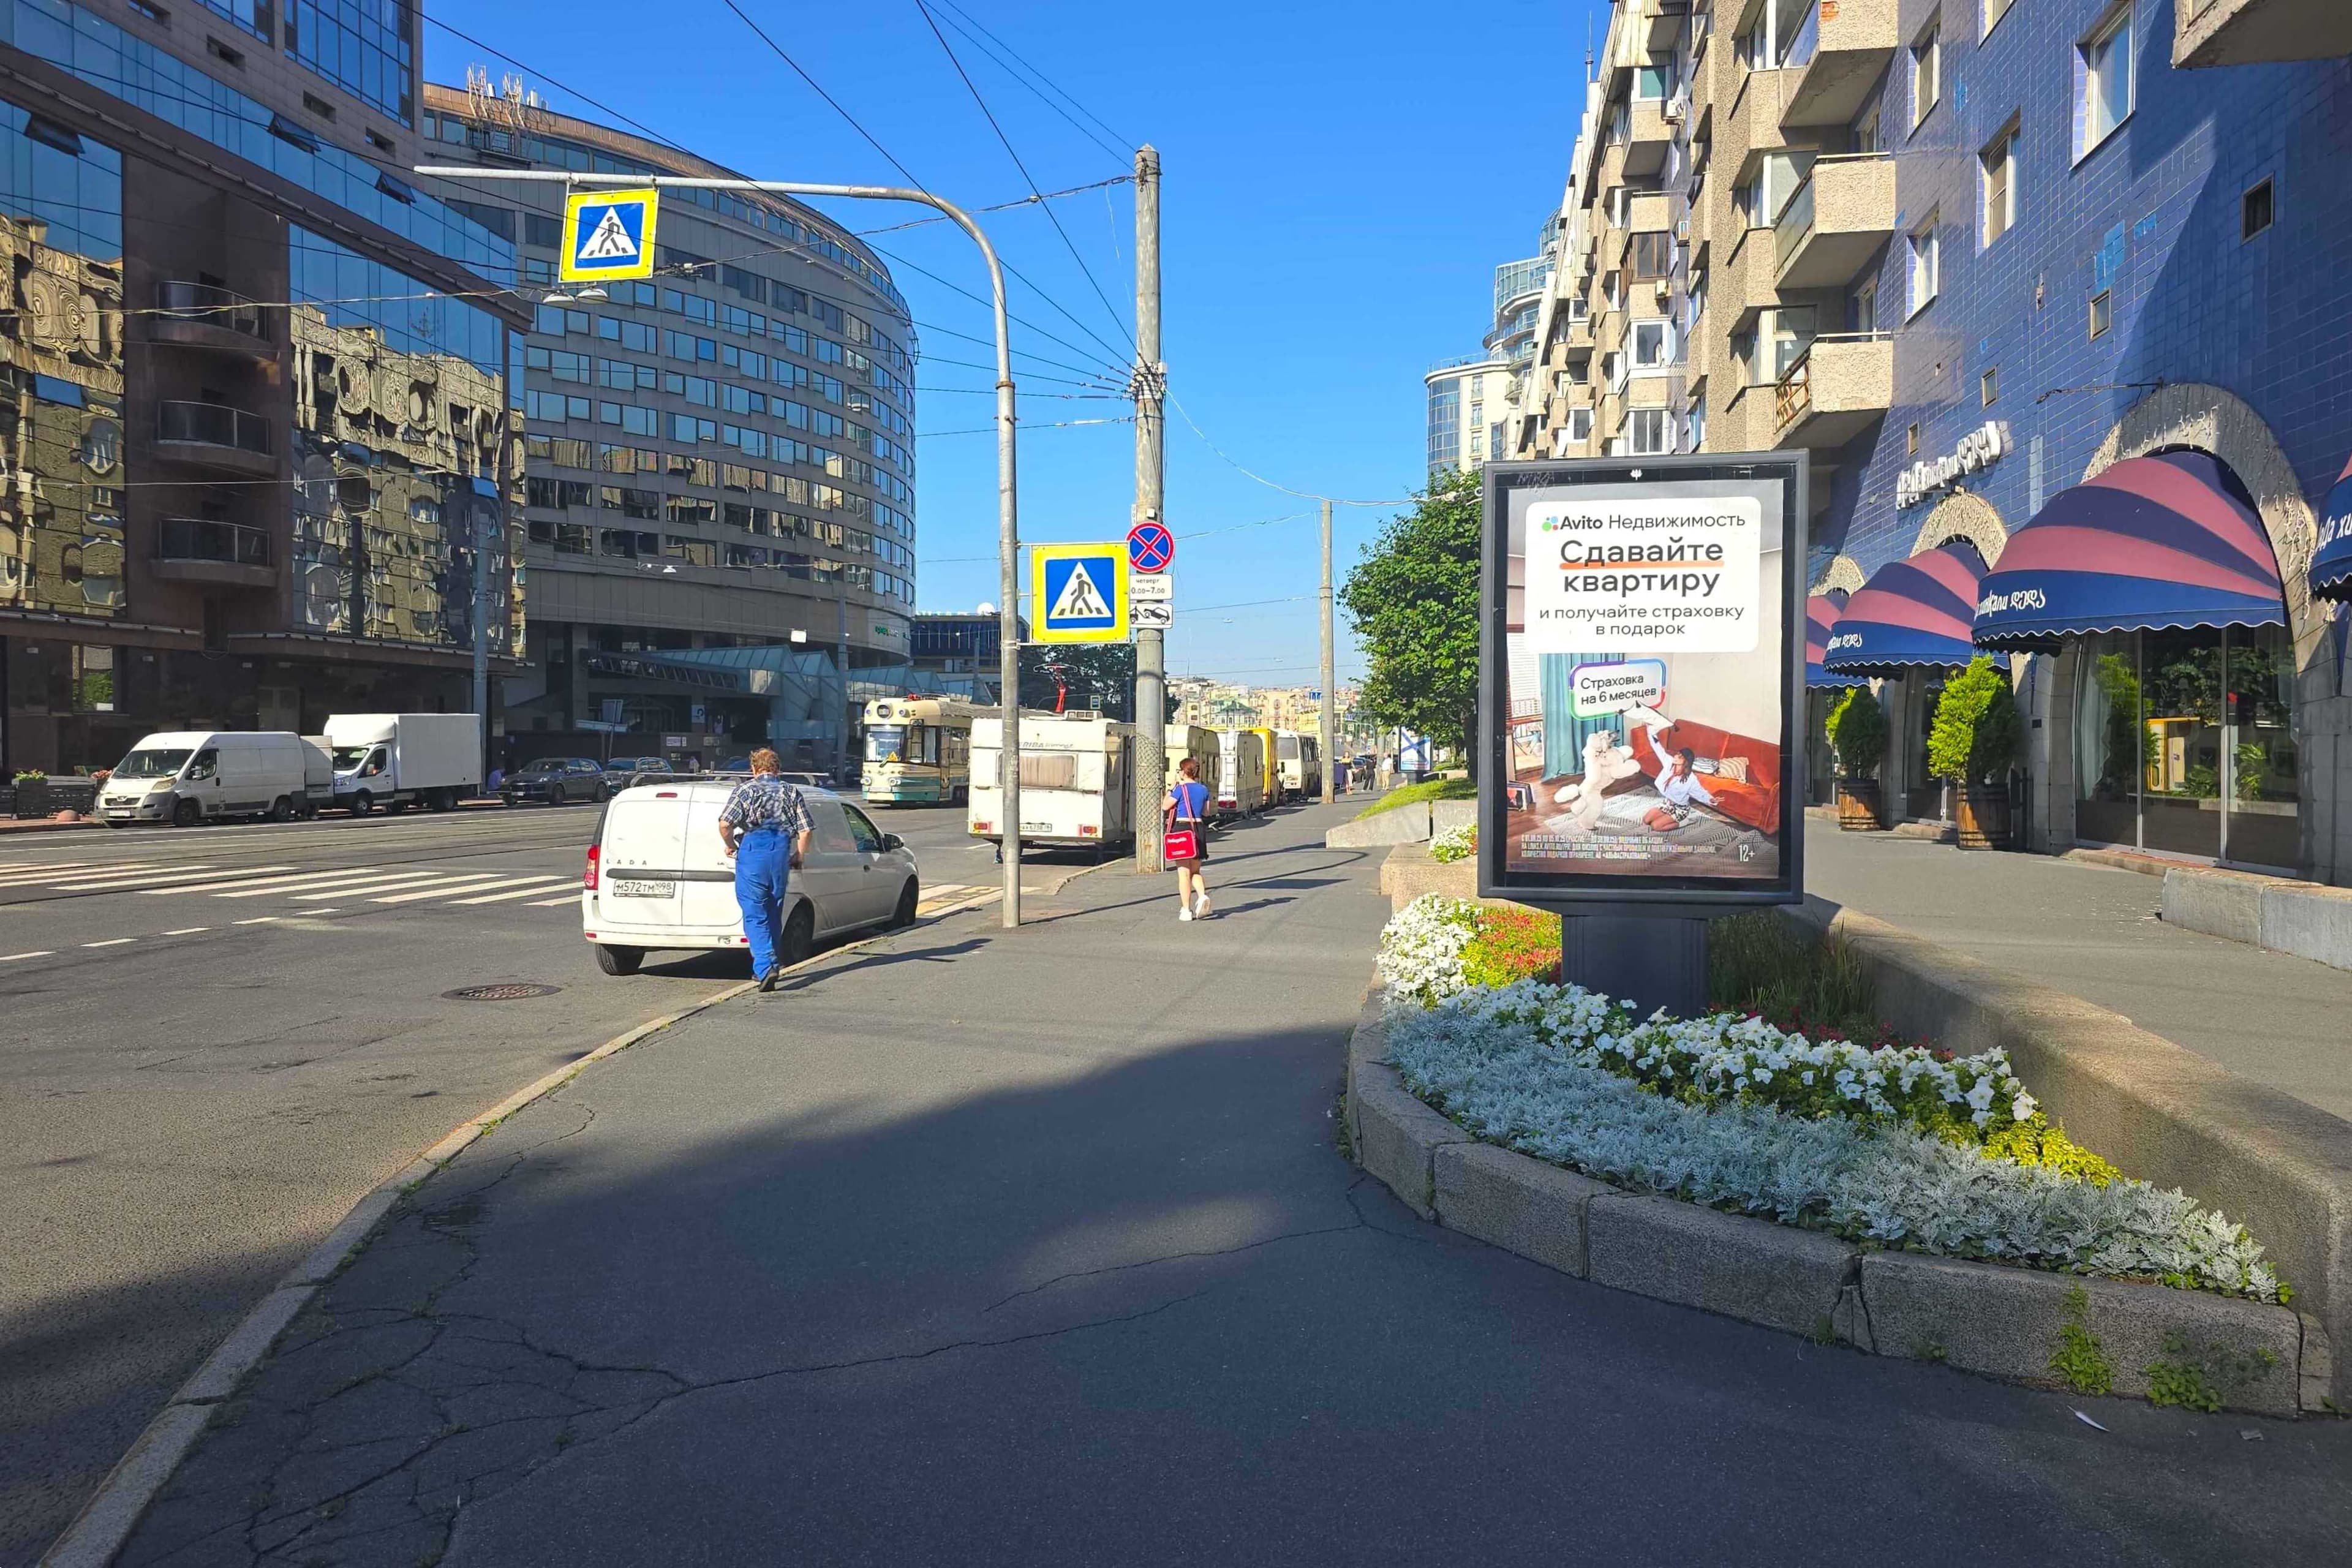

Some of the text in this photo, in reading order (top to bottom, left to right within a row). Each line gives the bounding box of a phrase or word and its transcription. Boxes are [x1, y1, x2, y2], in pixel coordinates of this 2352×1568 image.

[1559, 514, 1746, 531] Avito Недвижимость
[1561, 537, 1724, 567] Сдавайте
[1564, 570, 1721, 598] квартиру
[1555, 604, 1647, 622] получайте
[1651, 606, 1744, 620] страховку
[1596, 624, 1686, 638] в подарок
[1580, 674, 1644, 690] Страховка
[1581, 687, 1656, 706] на 6 месяцев
[1738, 844, 1755, 862] 12+
